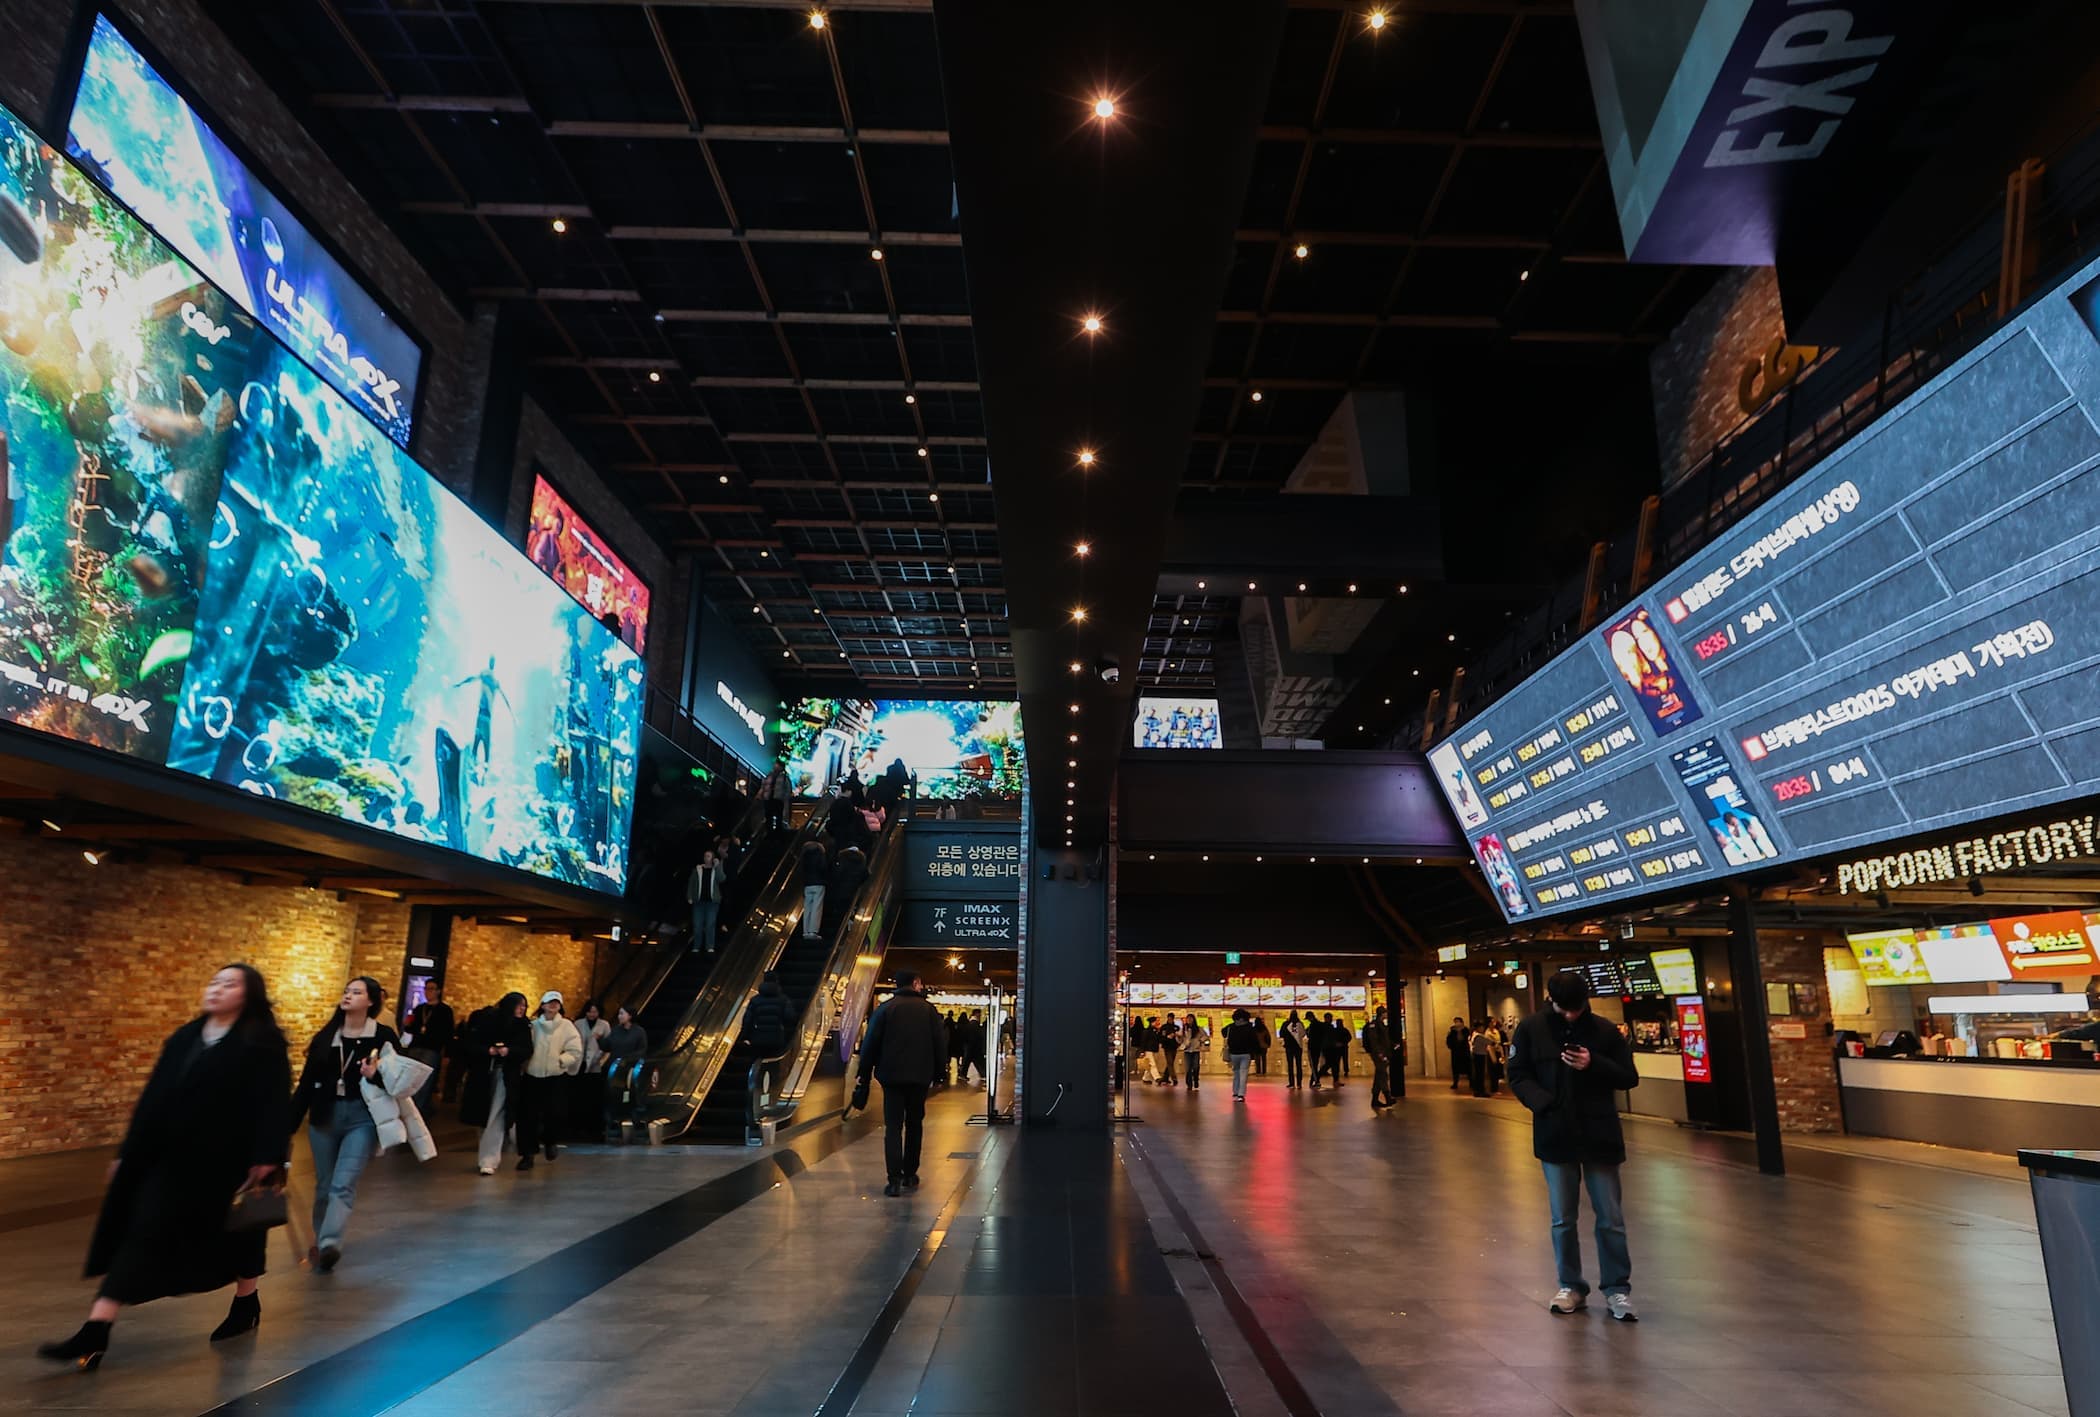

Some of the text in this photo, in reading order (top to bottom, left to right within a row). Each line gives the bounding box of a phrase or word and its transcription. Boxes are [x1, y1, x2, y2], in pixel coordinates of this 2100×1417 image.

[1703, 0, 1895, 168] EXP
[265, 267, 349, 366] ULTRA
[1891, 650, 1976, 698] 아카데미
[936, 845, 1019, 860] 모든 상영관은
[1837, 815, 2094, 895] POPCORN FACTORY
[928, 862, 1021, 878] 위층에 있습니다
[934, 904, 1001, 918] 7F IMAX
[955, 917, 1010, 926] SCREENX
[954, 929, 987, 937] ULTRA
[1228, 977, 1282, 988] SELF ORDER
